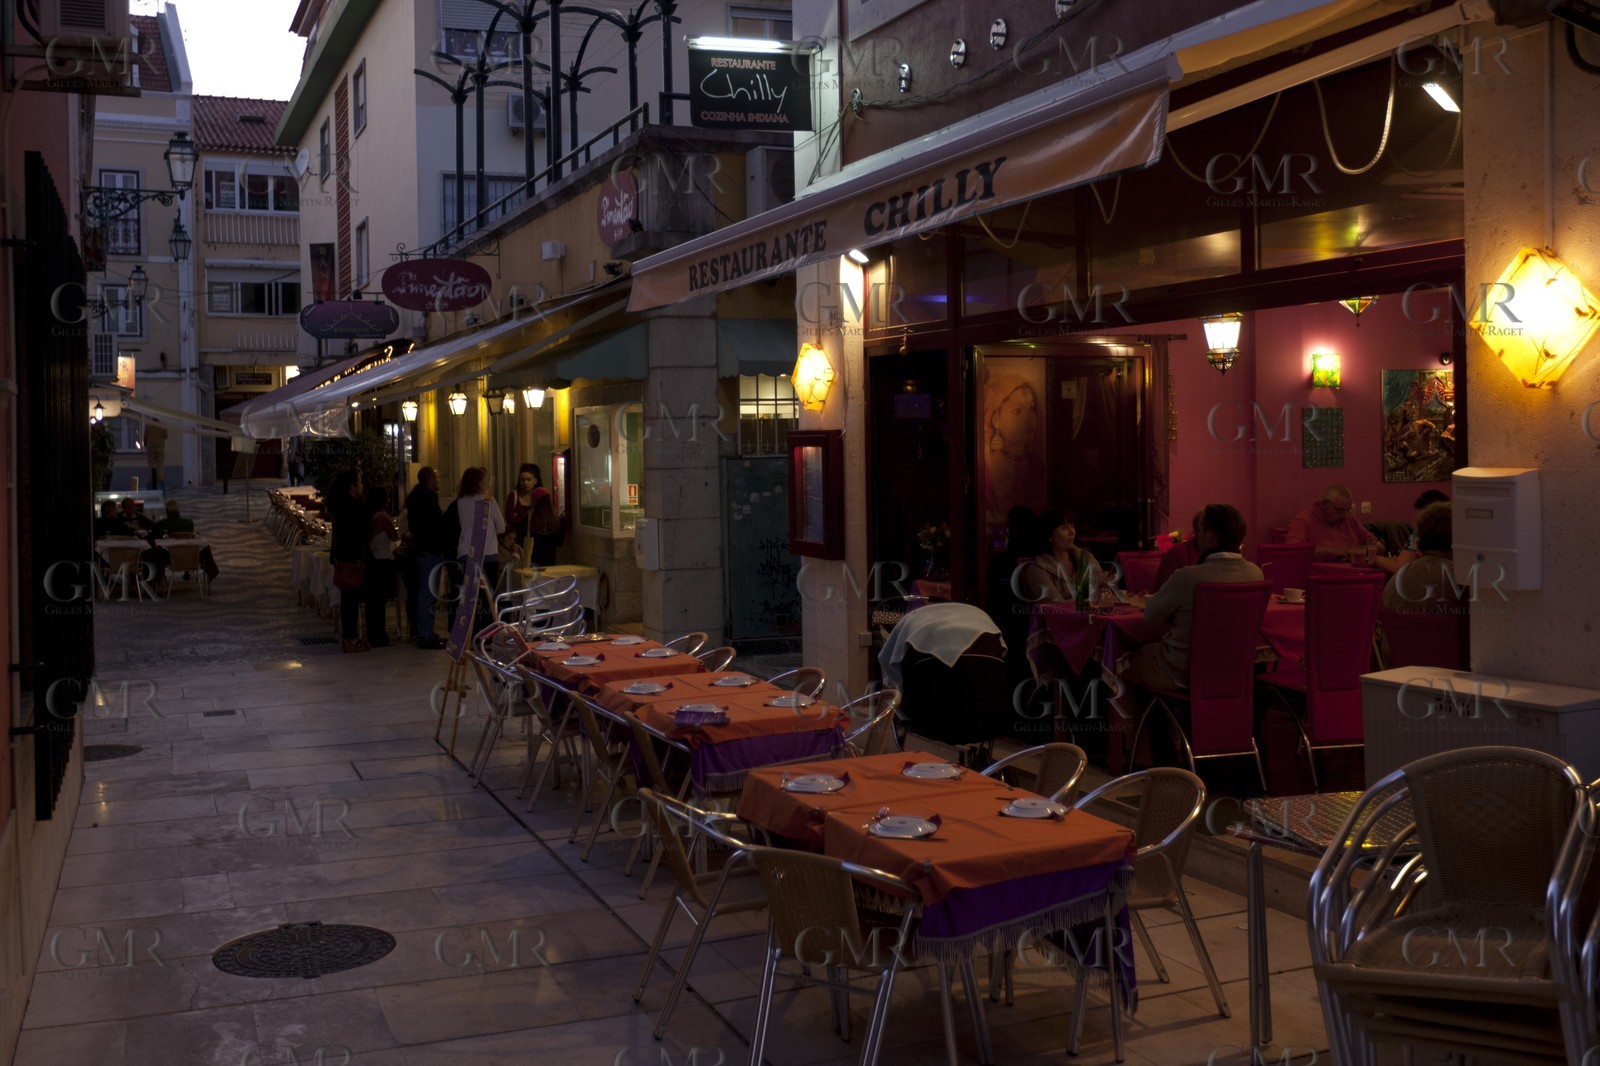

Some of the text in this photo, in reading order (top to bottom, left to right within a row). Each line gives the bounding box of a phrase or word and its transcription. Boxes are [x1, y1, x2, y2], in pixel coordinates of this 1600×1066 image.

[710, 57, 776, 70] RESTAURANTE
[700, 68, 788, 114] Chilly
[700, 111, 789, 124] COZINHA INDIANA
[688, 156, 1007, 291] RESTAURANTE CHILLY
